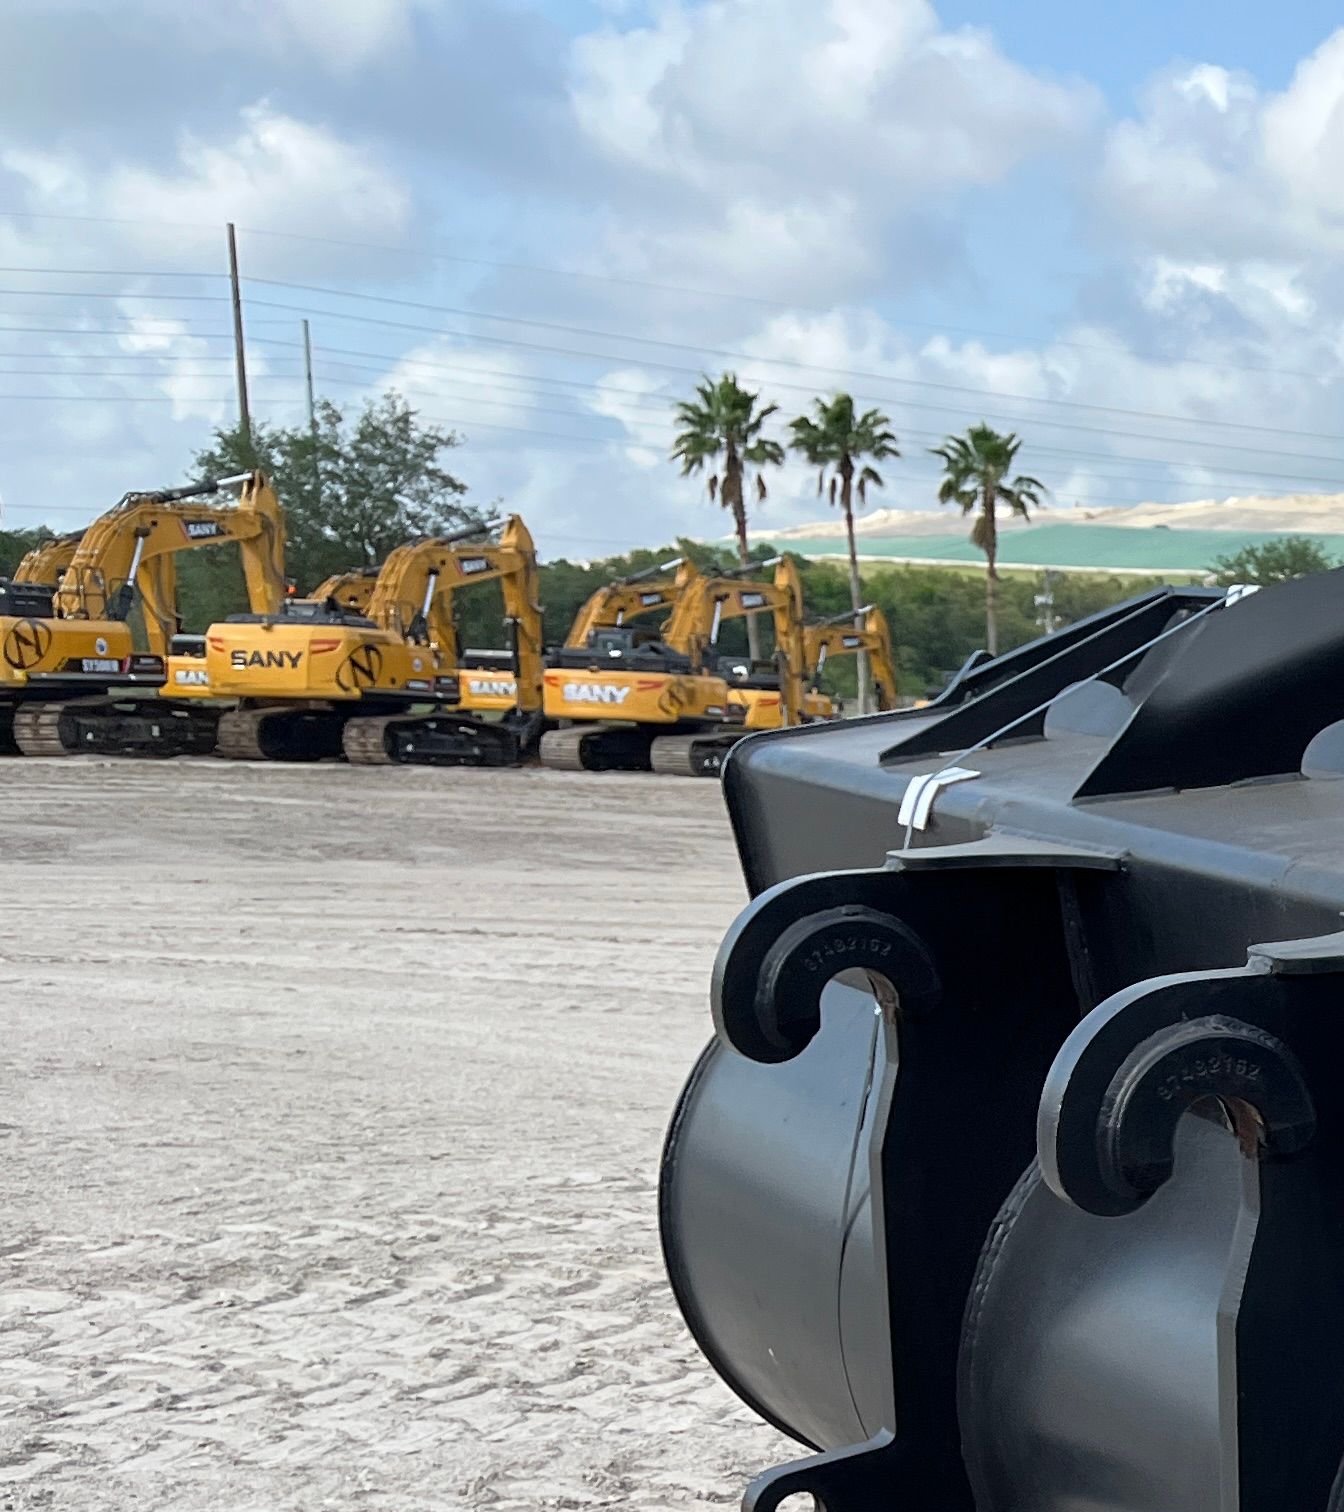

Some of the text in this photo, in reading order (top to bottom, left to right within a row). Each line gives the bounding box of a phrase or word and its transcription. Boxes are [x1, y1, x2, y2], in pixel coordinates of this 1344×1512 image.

[231, 650, 303, 670] SANY
[175, 670, 208, 685] SAN
[563, 683, 630, 704] SANY
